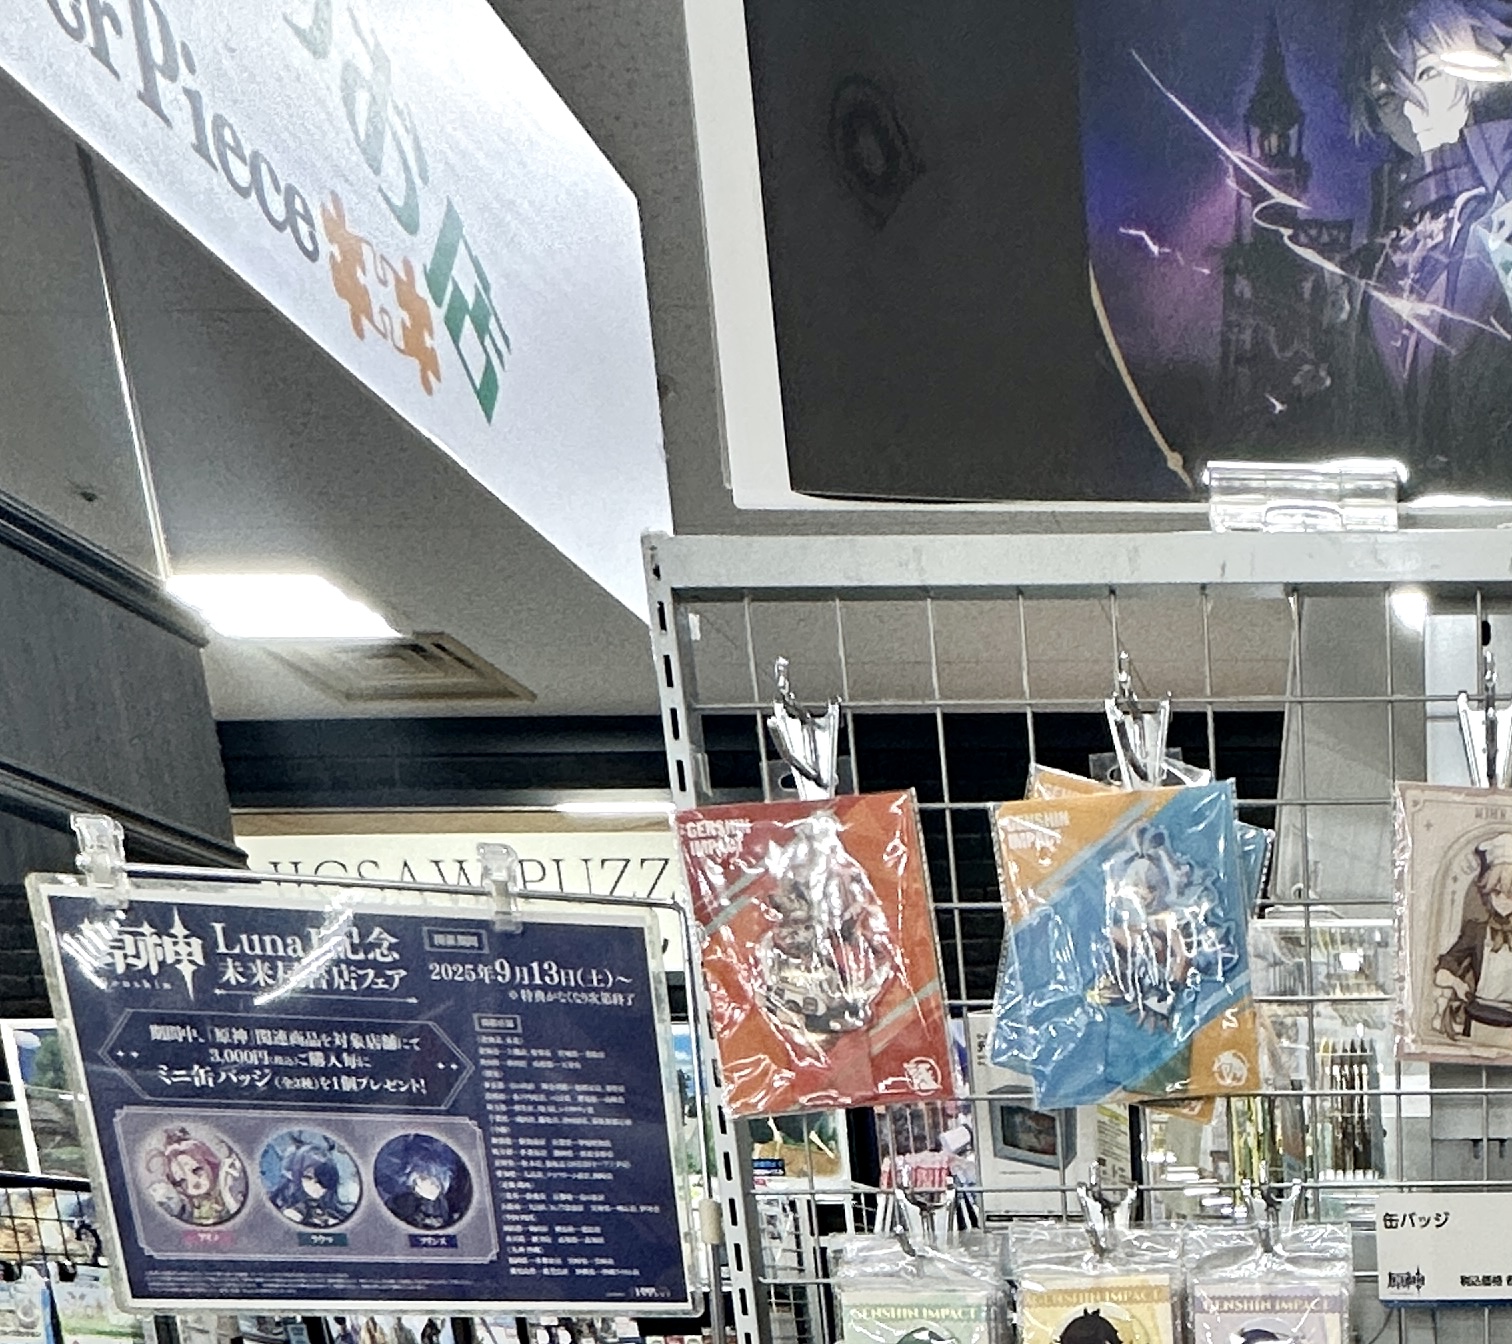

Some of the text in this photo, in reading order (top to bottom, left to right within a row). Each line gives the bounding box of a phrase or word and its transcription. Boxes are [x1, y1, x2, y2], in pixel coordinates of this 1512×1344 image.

[210, 921, 304, 957] Luna
[1382, 1212, 1450, 1230] 缶バッジ
